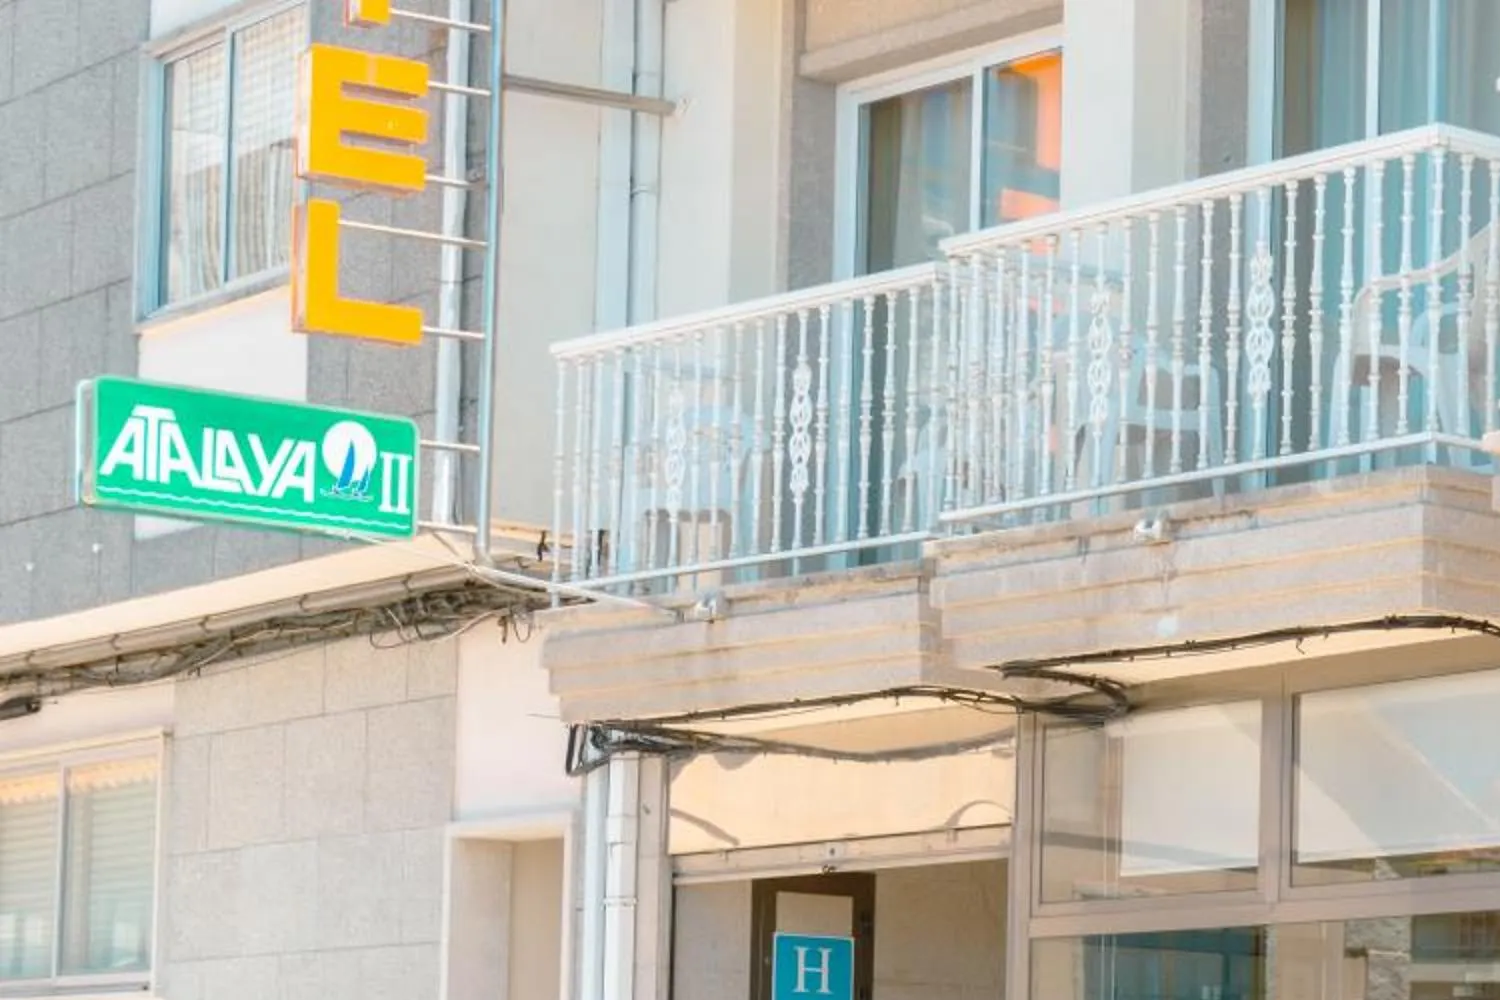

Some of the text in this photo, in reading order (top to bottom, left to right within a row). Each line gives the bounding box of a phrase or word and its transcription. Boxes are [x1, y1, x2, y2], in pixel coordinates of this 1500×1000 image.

[299, 0, 430, 347] EL
[99, 403, 413, 514] ATALAYA II
[791, 945, 834, 995] H
